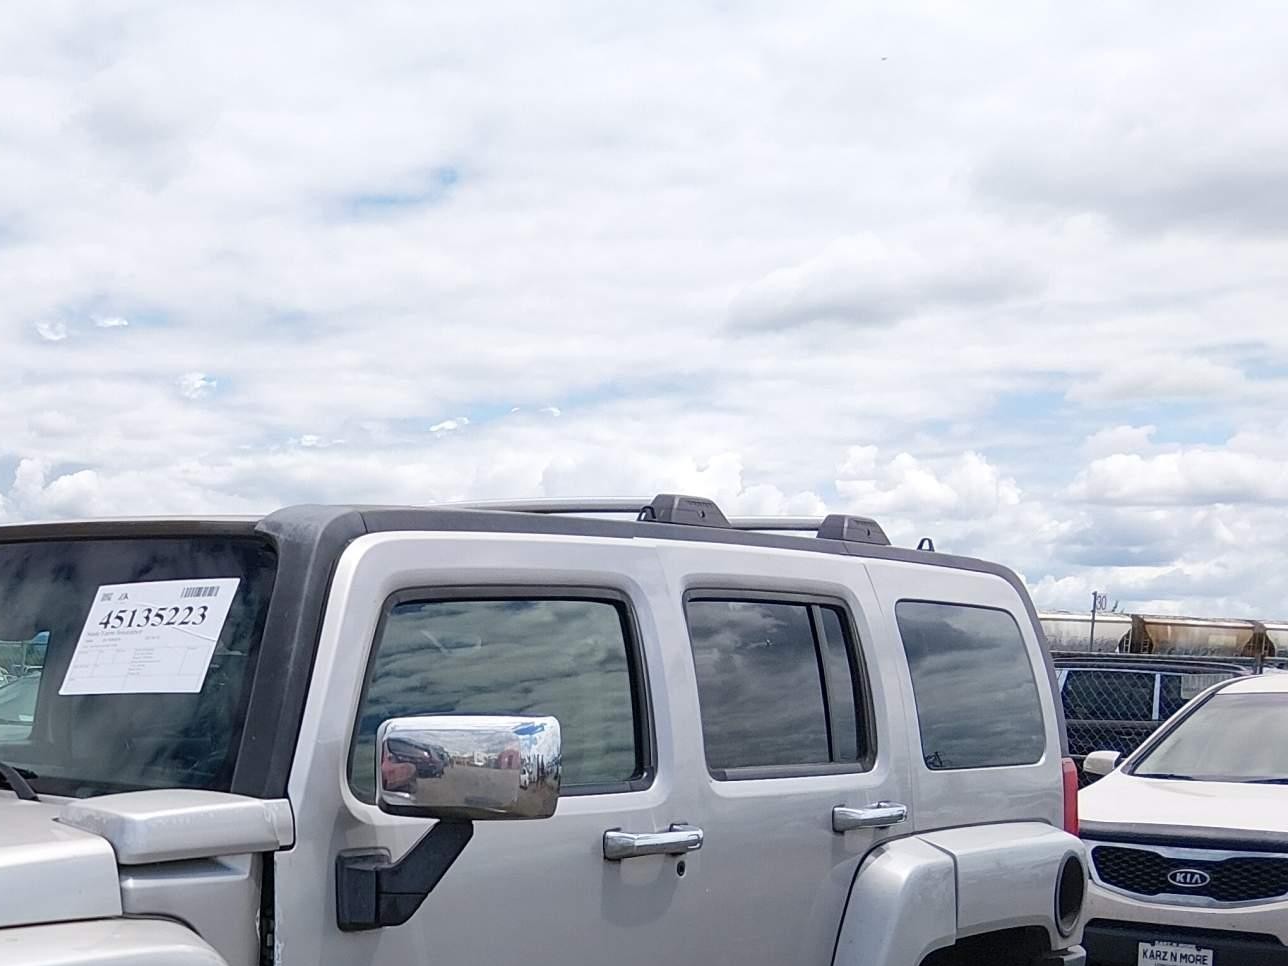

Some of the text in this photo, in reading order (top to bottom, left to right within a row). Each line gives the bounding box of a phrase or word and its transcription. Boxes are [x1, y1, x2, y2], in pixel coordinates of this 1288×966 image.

[1097, 595, 1107, 610] 30
[98, 605, 209, 630] 45135223
[1176, 872, 1202, 883] KIA
[1142, 948, 1209, 966] KARZ N MORE
